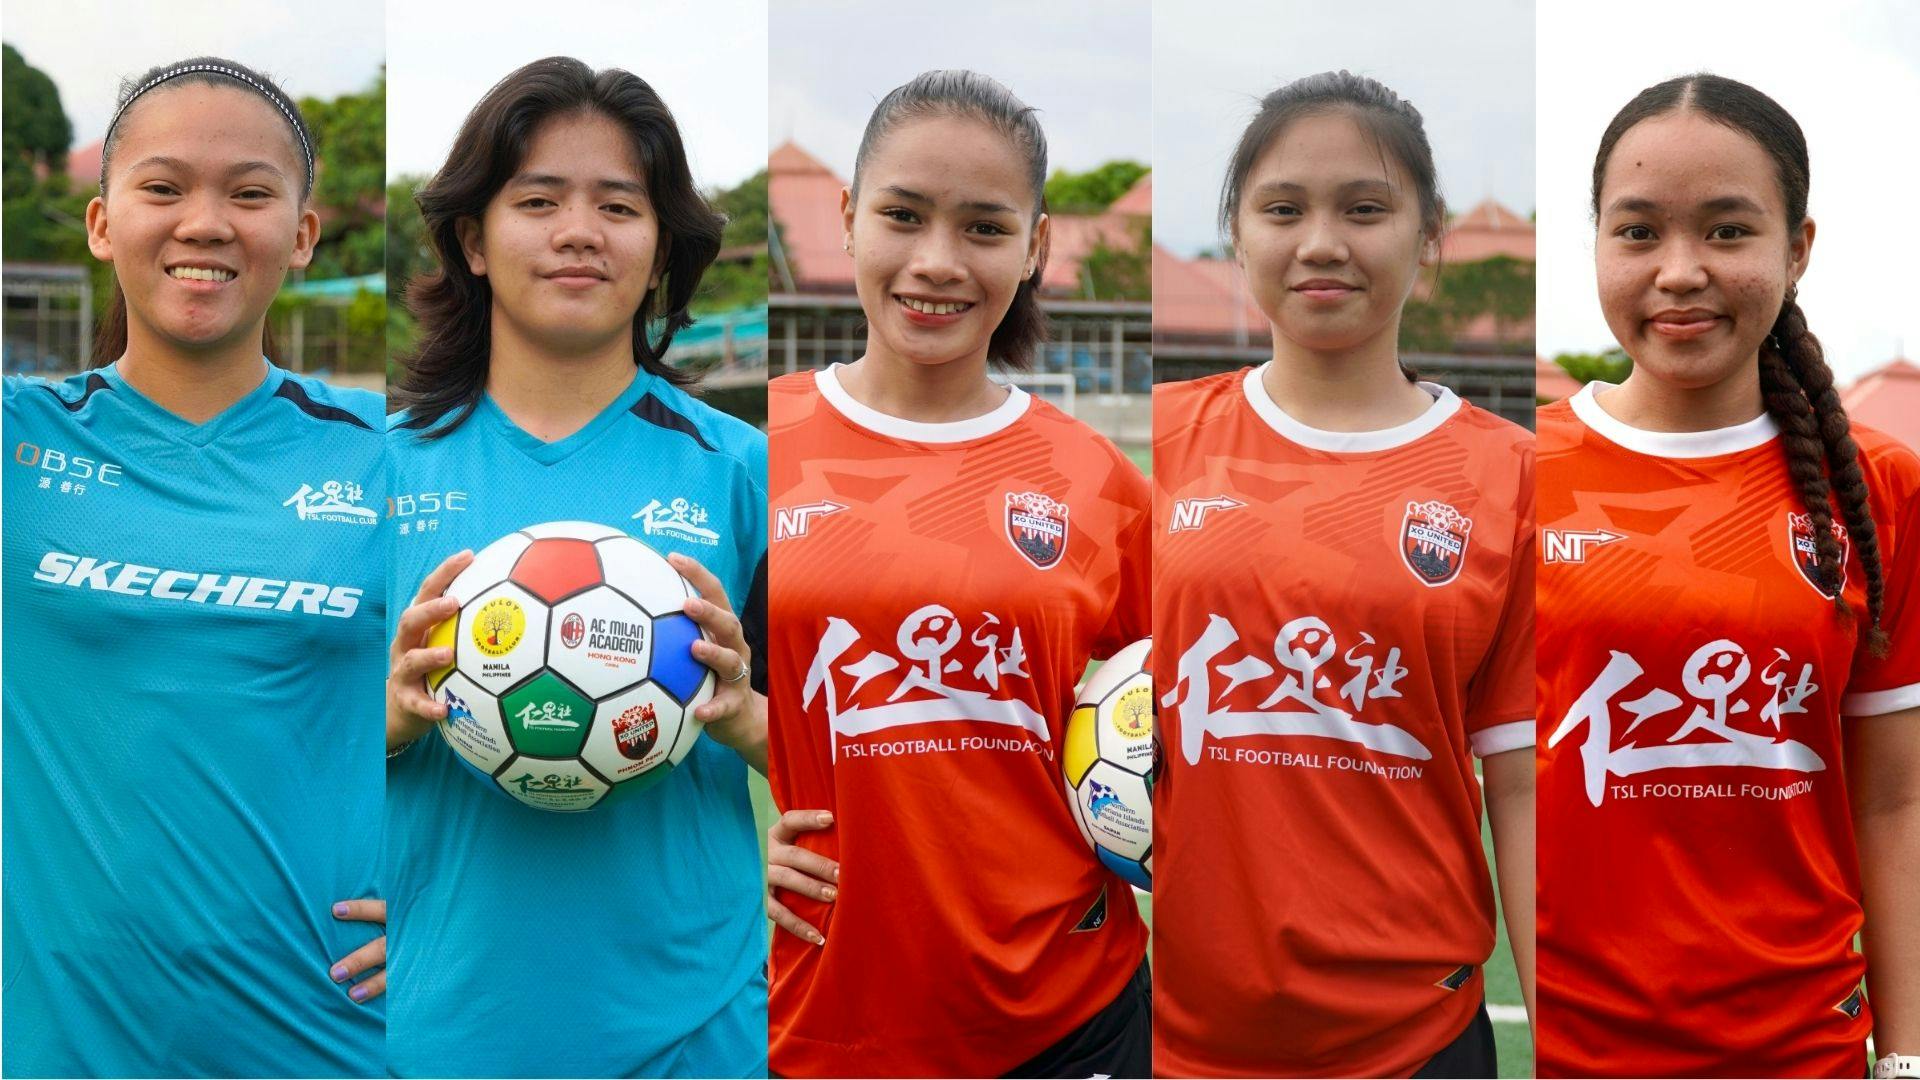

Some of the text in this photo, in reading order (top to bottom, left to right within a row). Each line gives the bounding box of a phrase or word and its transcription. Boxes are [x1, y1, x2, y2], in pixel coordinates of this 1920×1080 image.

[16, 441, 122, 486] OBSE
[307, 513, 377, 525] TSL FOOTBALL CLUB
[1028, 518, 1062, 532] UNITED
[653, 528, 719, 546] TSL FOOTBALL CLUB
[1411, 527, 1460, 549] XO UNITED
[1798, 540, 1810, 548] XO
[33, 551, 364, 619] SKECHERS
[590, 618, 644, 639] AC MILAN
[589, 634, 644, 655] ACADEMY
[587, 652, 612, 661] HONG
[613, 656, 637, 665] KONG
[842, 743, 868, 759] TSL
[870, 738, 956, 757] FOOTBALL
[1208, 746, 1231, 762] TSL
[1235, 749, 1323, 769] FOOTBALL
[1611, 785, 1638, 799] TSL
[1643, 784, 1737, 799] FOOTBALL
